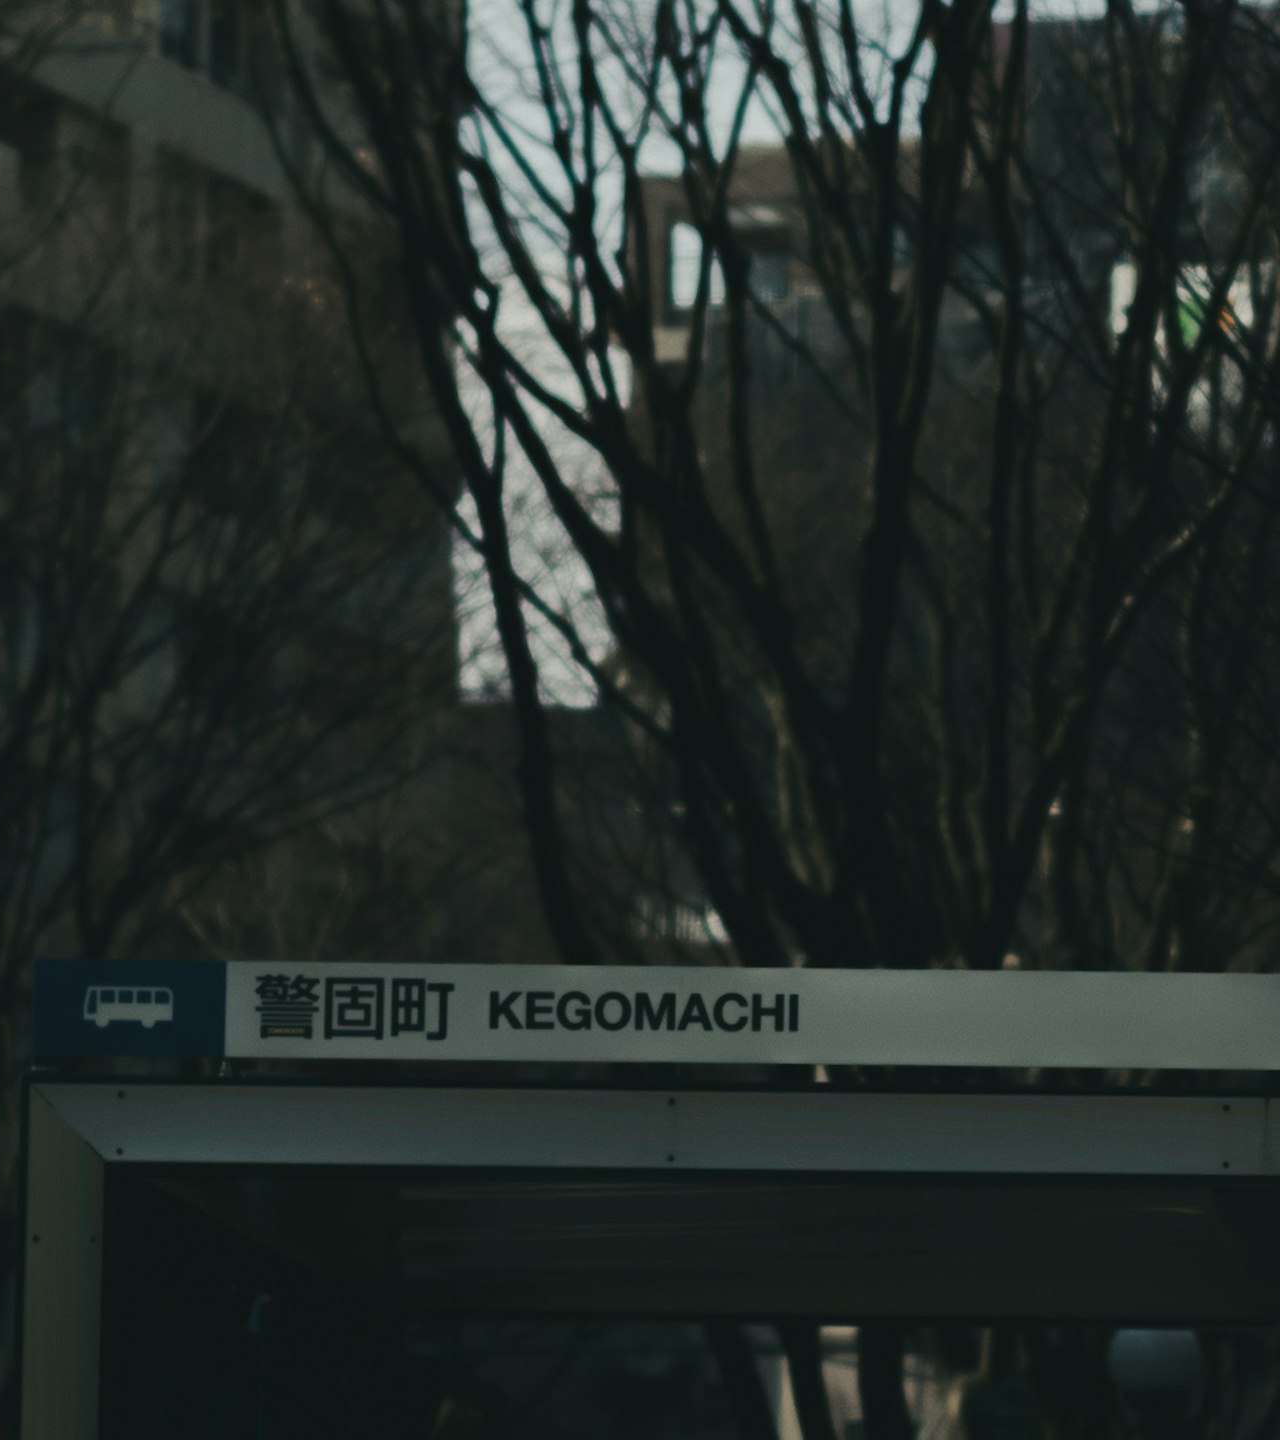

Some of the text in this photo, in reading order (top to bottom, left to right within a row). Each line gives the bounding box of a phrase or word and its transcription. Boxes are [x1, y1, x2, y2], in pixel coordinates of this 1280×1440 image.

[254, 973, 800, 1041] 警固町 KEGOMACHI
